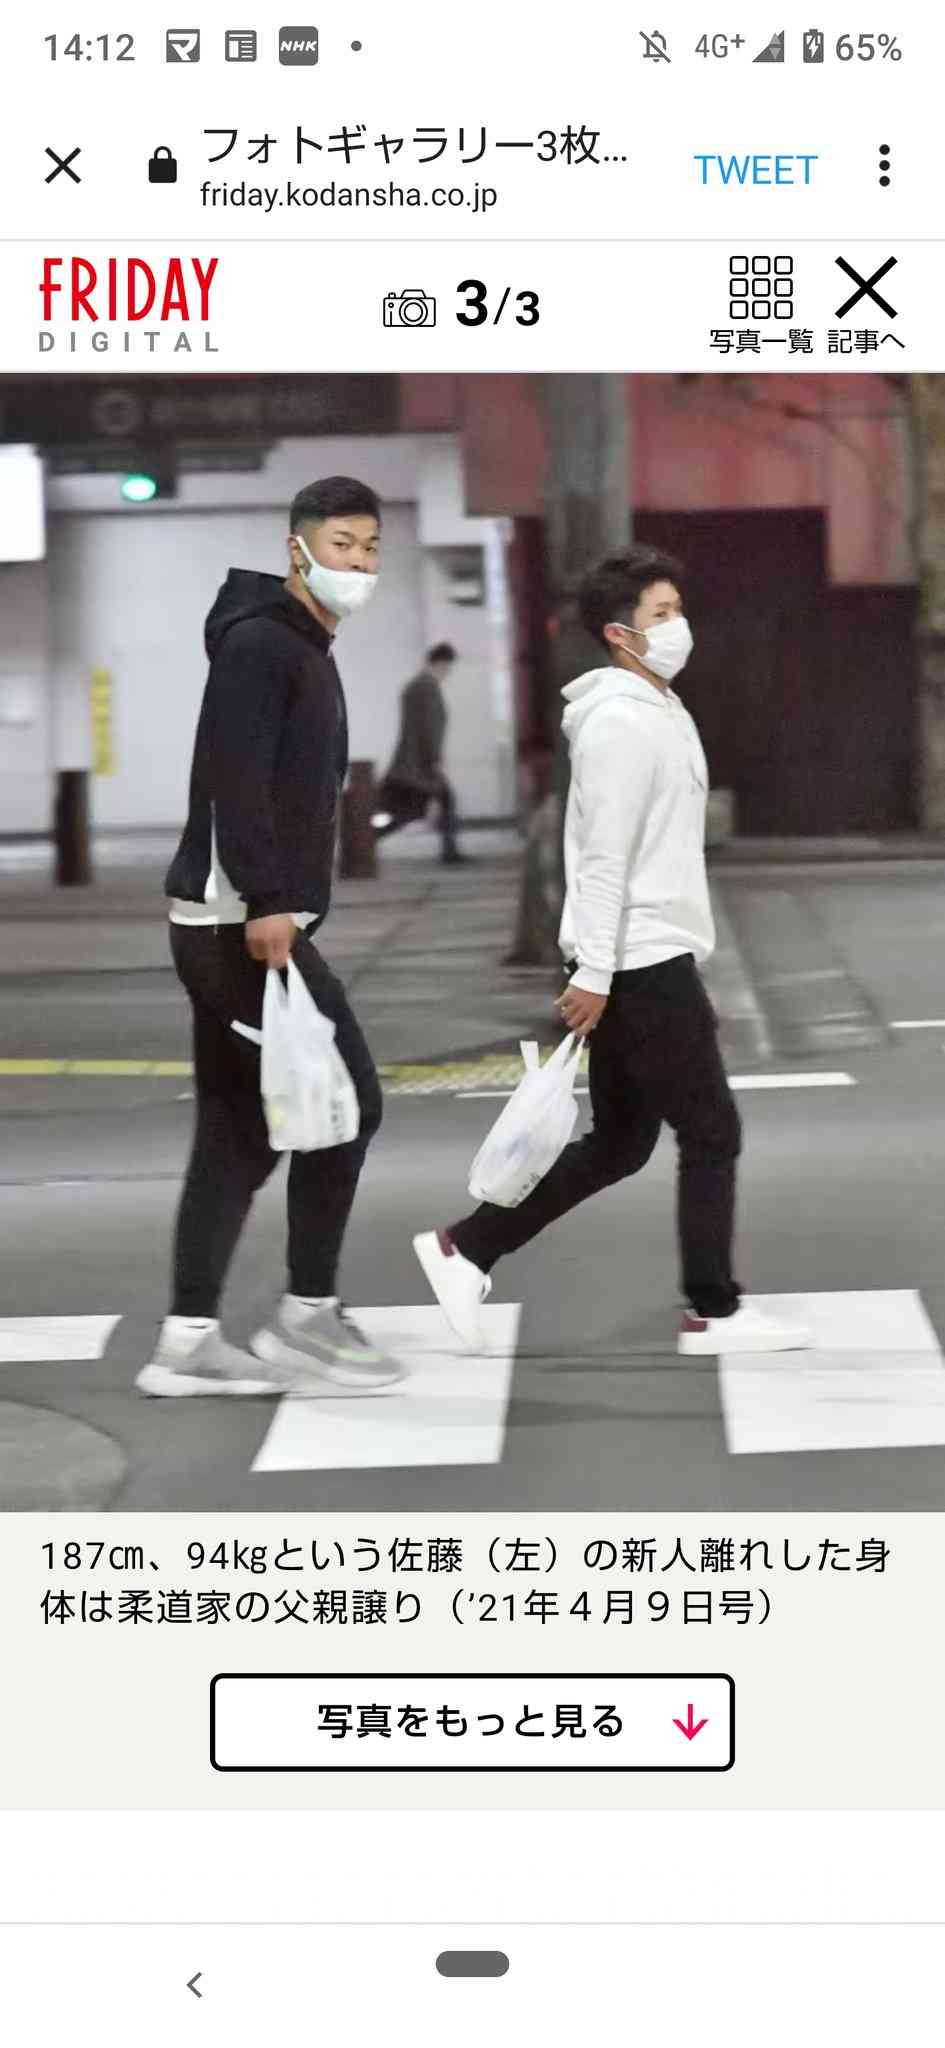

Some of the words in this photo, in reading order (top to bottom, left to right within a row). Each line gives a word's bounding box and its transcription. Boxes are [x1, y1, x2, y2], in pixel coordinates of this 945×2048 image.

[45, 34, 135, 61] 14:12
[280, 40, 318, 52] NHK
[836, 34, 903, 62] 65%
[694, 155, 819, 185] TWEET
[200, 181, 498, 213] friday.kodansha.co.jp
[39, 257, 220, 323] FRIDAY
[39, 332, 219, 353] DIGITAL
[709, 328, 814, 355] 写真一覧
[827, 328, 907, 355] 記事へ
[317, 1702, 623, 1740] 写真をもっと見る
